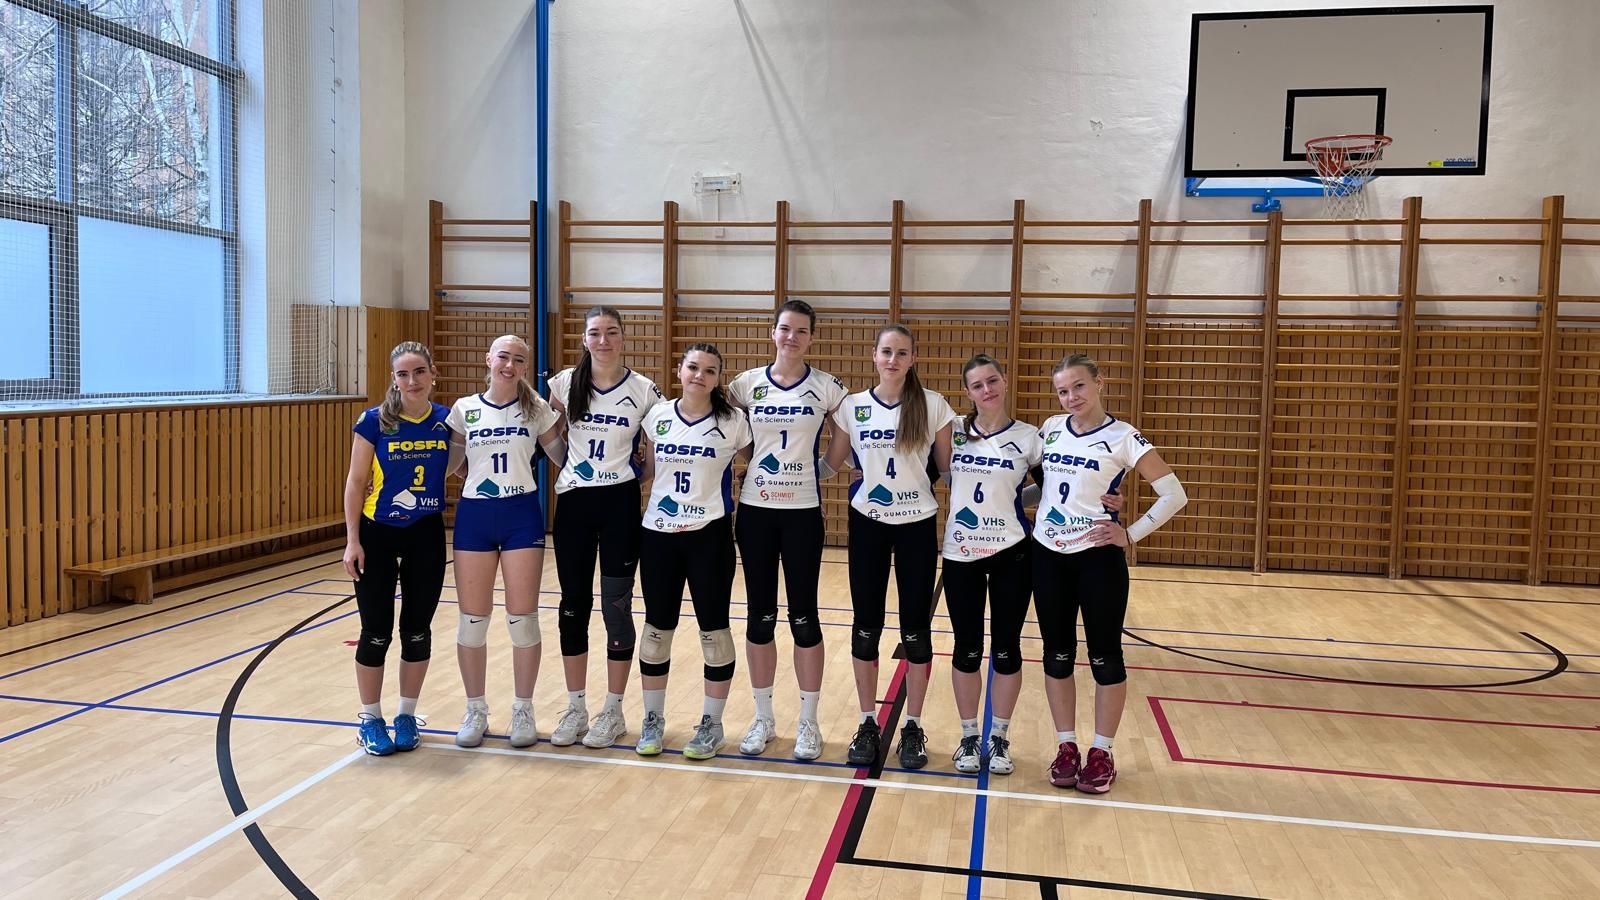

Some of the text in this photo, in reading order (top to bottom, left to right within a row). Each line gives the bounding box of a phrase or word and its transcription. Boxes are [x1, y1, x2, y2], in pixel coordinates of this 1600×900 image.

[754, 405, 815, 416] FOSFA
[580, 412, 630, 428] OSFA
[469, 426, 530, 440] FOSFA
[581, 424, 609, 433] Science
[779, 430, 788, 450] 1
[860, 429, 896, 441] FOS
[388, 440, 447, 453] FOSFA
[588, 438, 605, 461] 14
[656, 443, 716, 458] FOSFA
[388, 453, 402, 461] Life
[664, 456, 694, 464] Science
[952, 454, 1015, 470] FOSFA
[1042, 453, 1100, 471] FOSFA
[491, 452, 508, 474] 11
[783, 462, 803, 471] VHS
[885, 457, 897, 479] 4
[413, 465, 425, 486] 3
[598, 471, 619, 480] VHS
[961, 466, 992, 475] Science
[1049, 466, 1077, 475] Science
[673, 471, 691, 494] 15
[503, 485, 525, 494] VHS
[973, 482, 984, 504] 6
[1058, 482, 1070, 504] 9
[897, 491, 919, 500] VHS
[420, 497, 439, 507] VHS
[683, 505, 706, 515] VHS
[884, 509, 922, 517] GUMOTEX
[982, 517, 1006, 527] VHS
[971, 547, 997, 555] SCHMIDT
